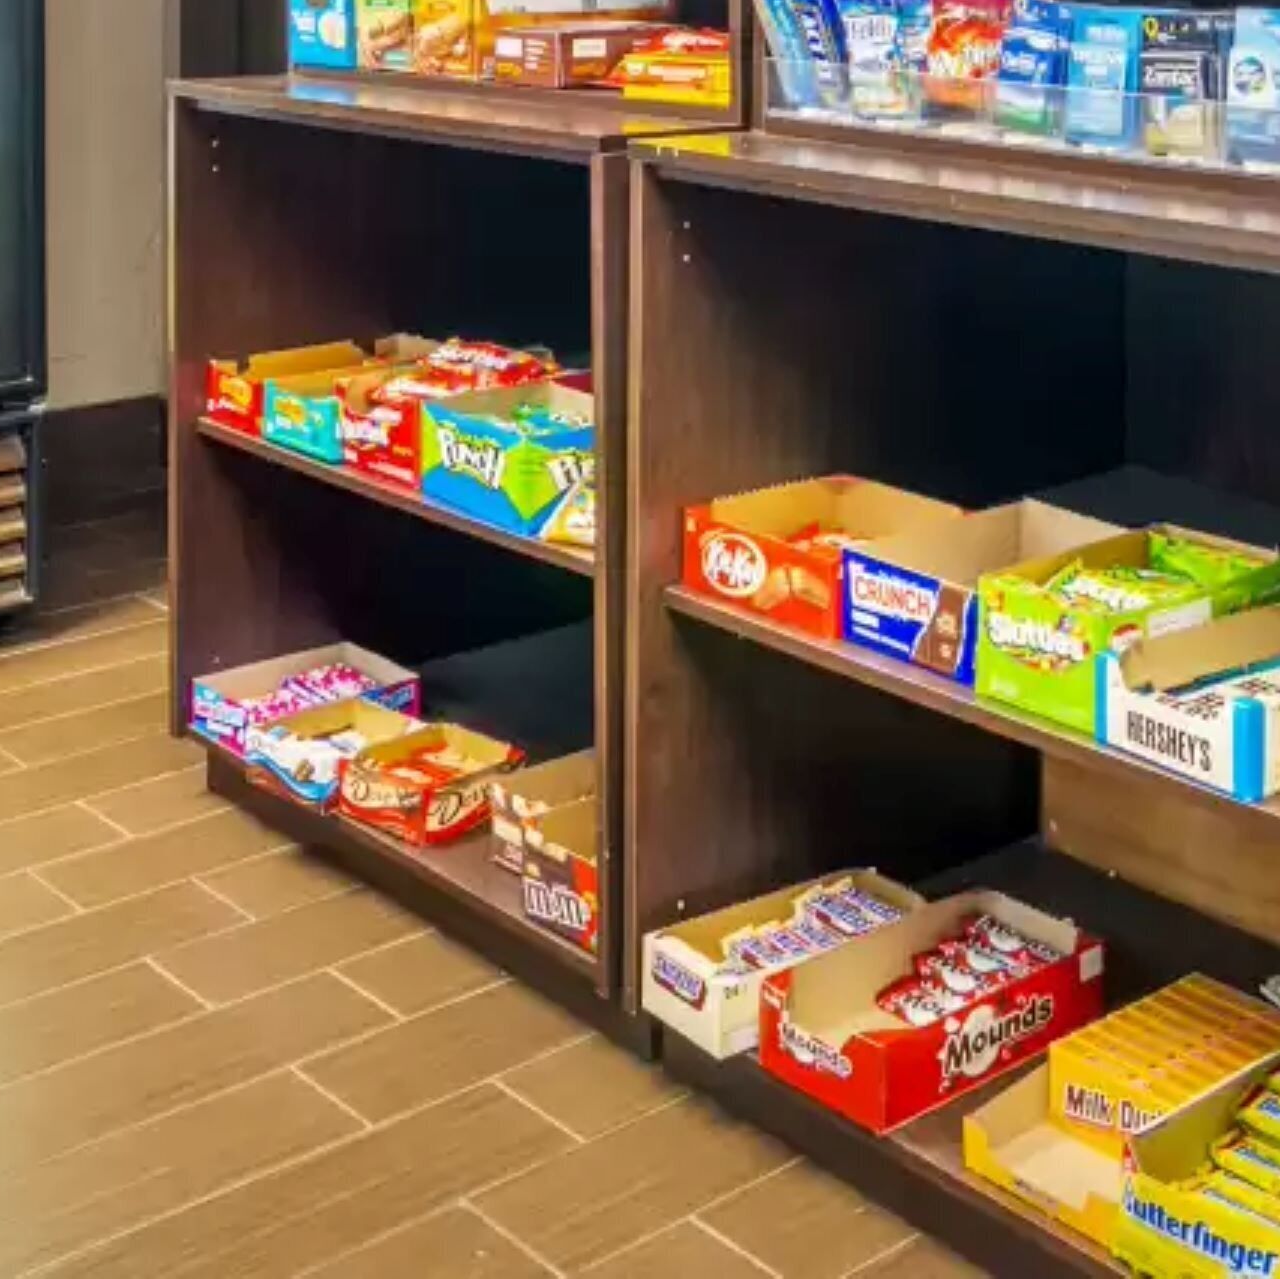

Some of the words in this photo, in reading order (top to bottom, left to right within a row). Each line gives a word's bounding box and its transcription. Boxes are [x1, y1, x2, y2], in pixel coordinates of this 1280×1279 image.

[853, 574, 932, 617] CRUNCH
[1126, 710, 1212, 772] HERSHEY'S
[780, 1023, 853, 1079] Mounds
[942, 993, 1055, 1074] Mounds
[1064, 1085, 1112, 1121] Milk
